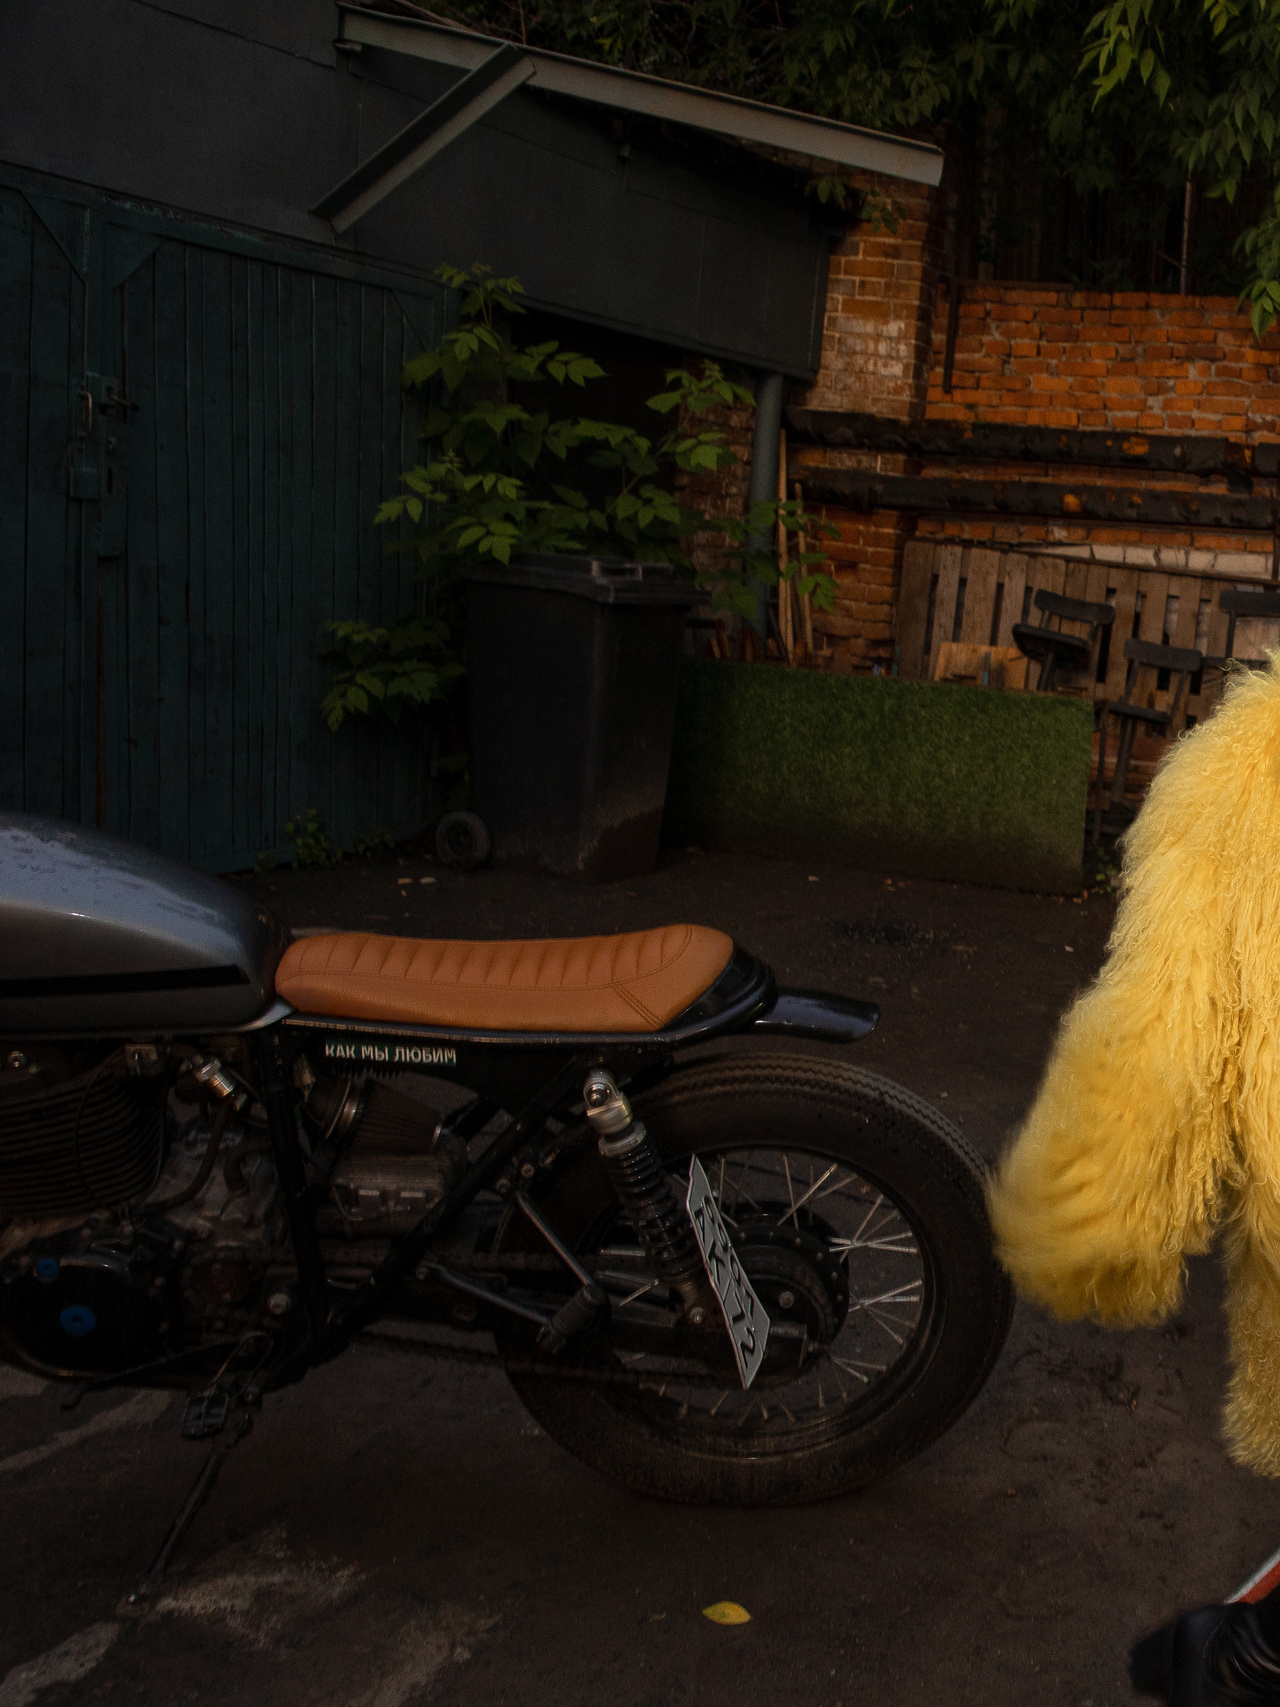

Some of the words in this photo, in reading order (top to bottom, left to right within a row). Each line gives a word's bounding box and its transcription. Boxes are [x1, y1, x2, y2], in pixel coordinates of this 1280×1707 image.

[325, 1043, 356, 1059] КАК
[361, 1044, 389, 1062] МЫ
[393, 1045, 457, 1064] ЛЮБИМ
[732, 1293, 756, 1370] 72
